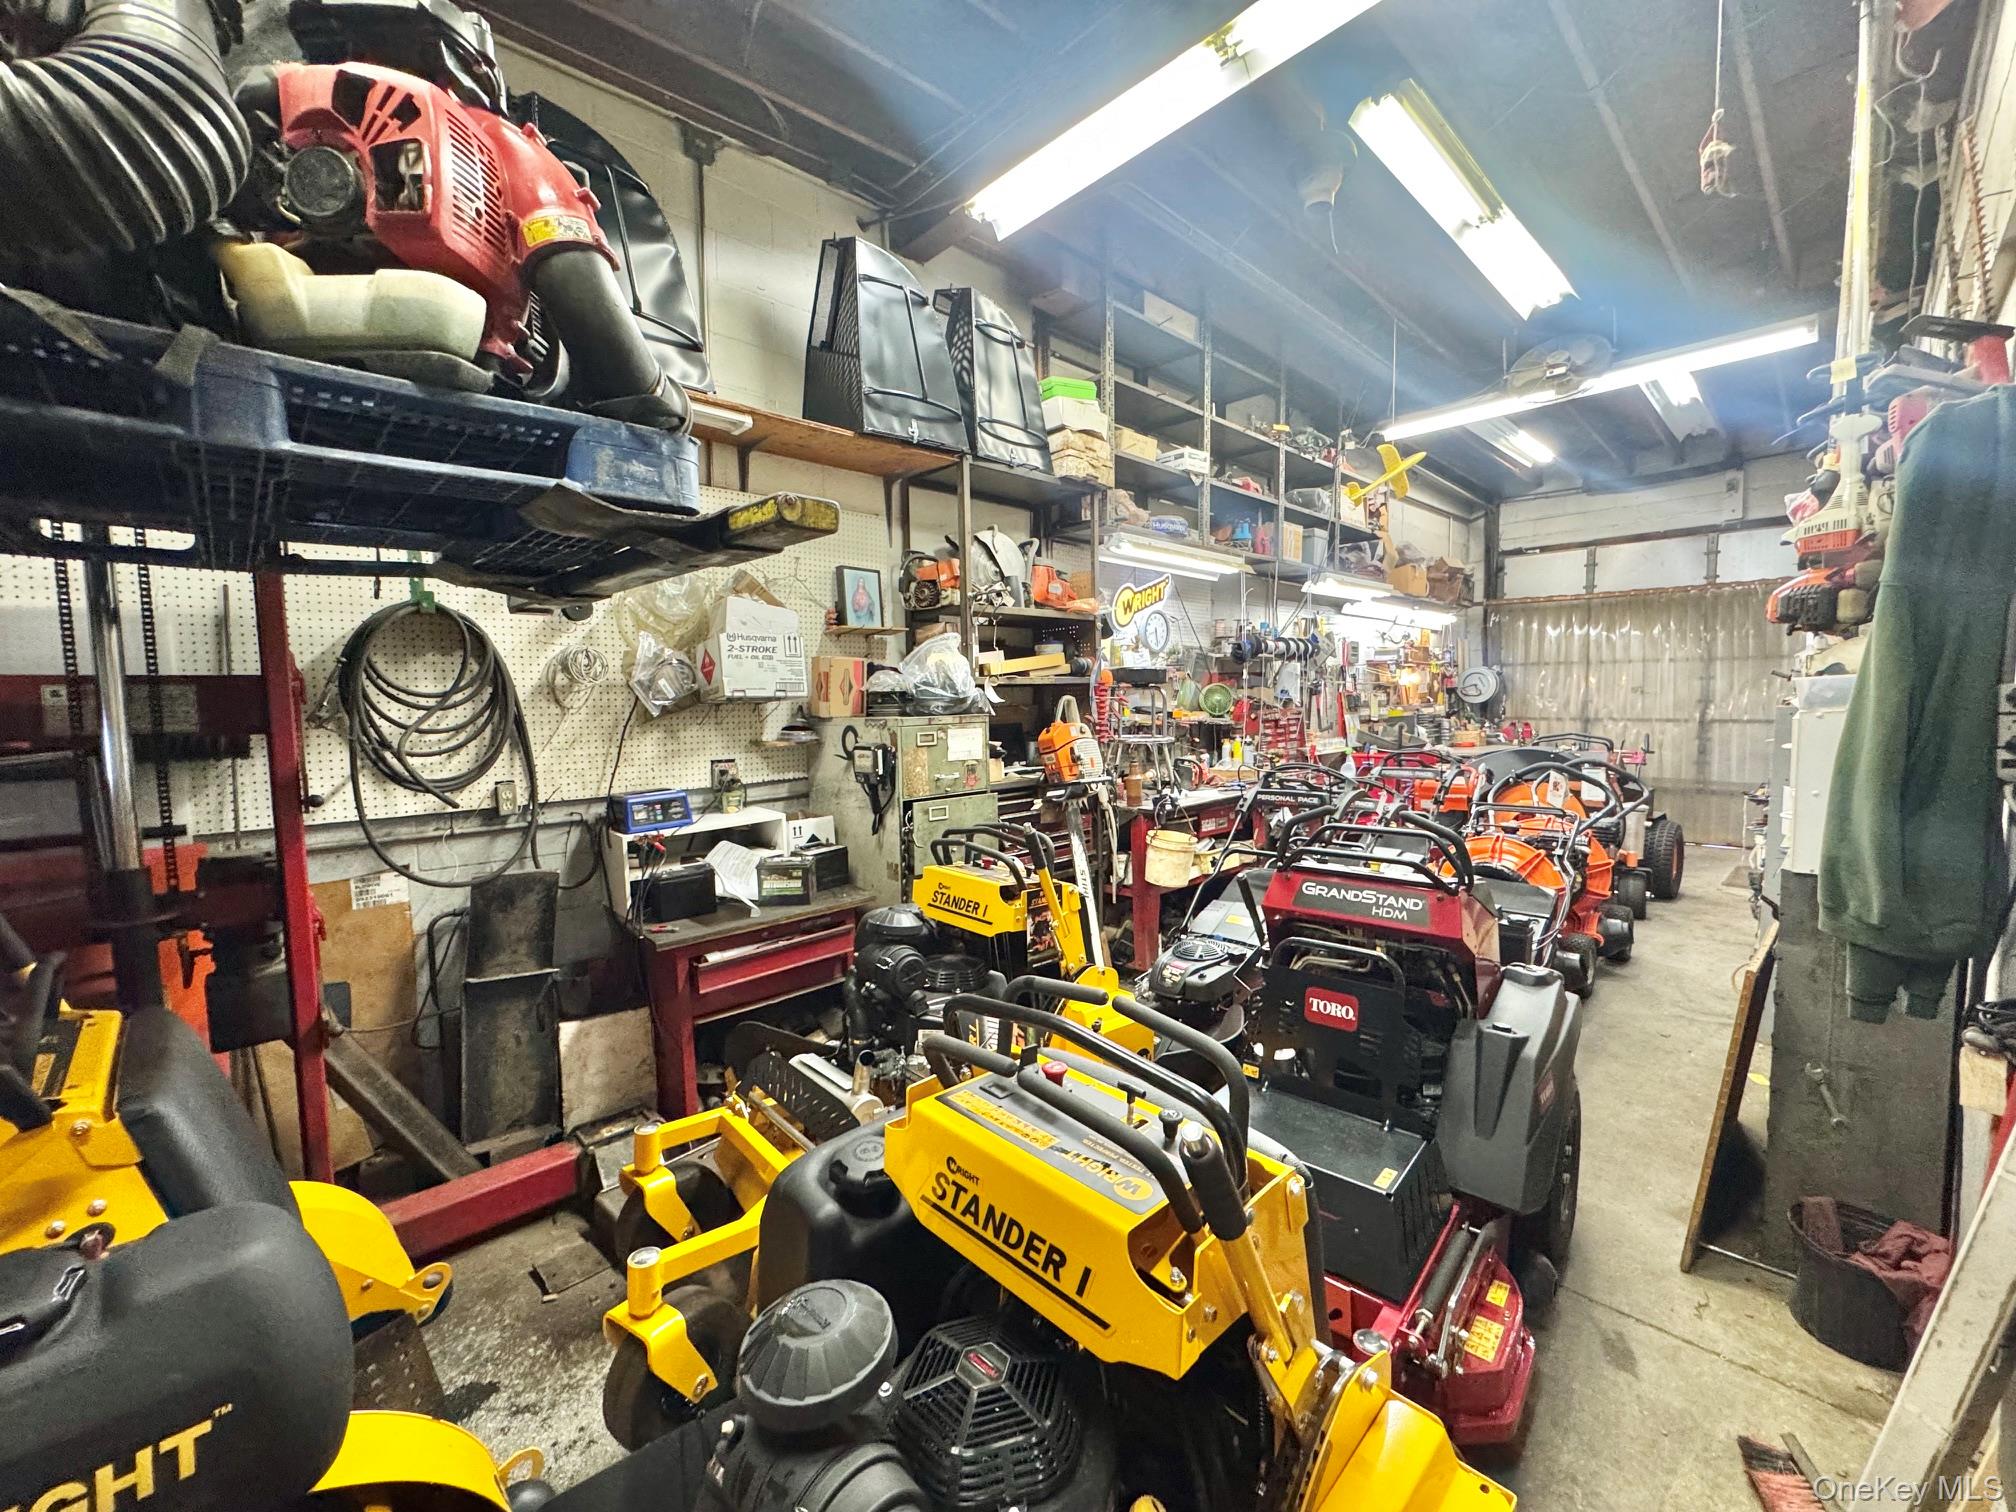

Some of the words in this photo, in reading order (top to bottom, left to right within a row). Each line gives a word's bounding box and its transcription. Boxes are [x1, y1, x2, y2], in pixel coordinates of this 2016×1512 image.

[1121, 580, 1168, 615] WRIGHT
[727, 644, 778, 654] 2-STROKE
[736, 632, 777, 643] Husqvarna
[1256, 793, 1296, 802] PERSONAL
[1297, 796, 1319, 804] PACE
[932, 890, 981, 915] STANDER
[982, 904, 989, 918] I
[1371, 905, 1408, 921] HDM
[1309, 997, 1355, 1020] TORO
[945, 1156, 981, 1186] WRIGHT
[931, 1171, 1067, 1283] STANDER
[1075, 1266, 1092, 1298] I
